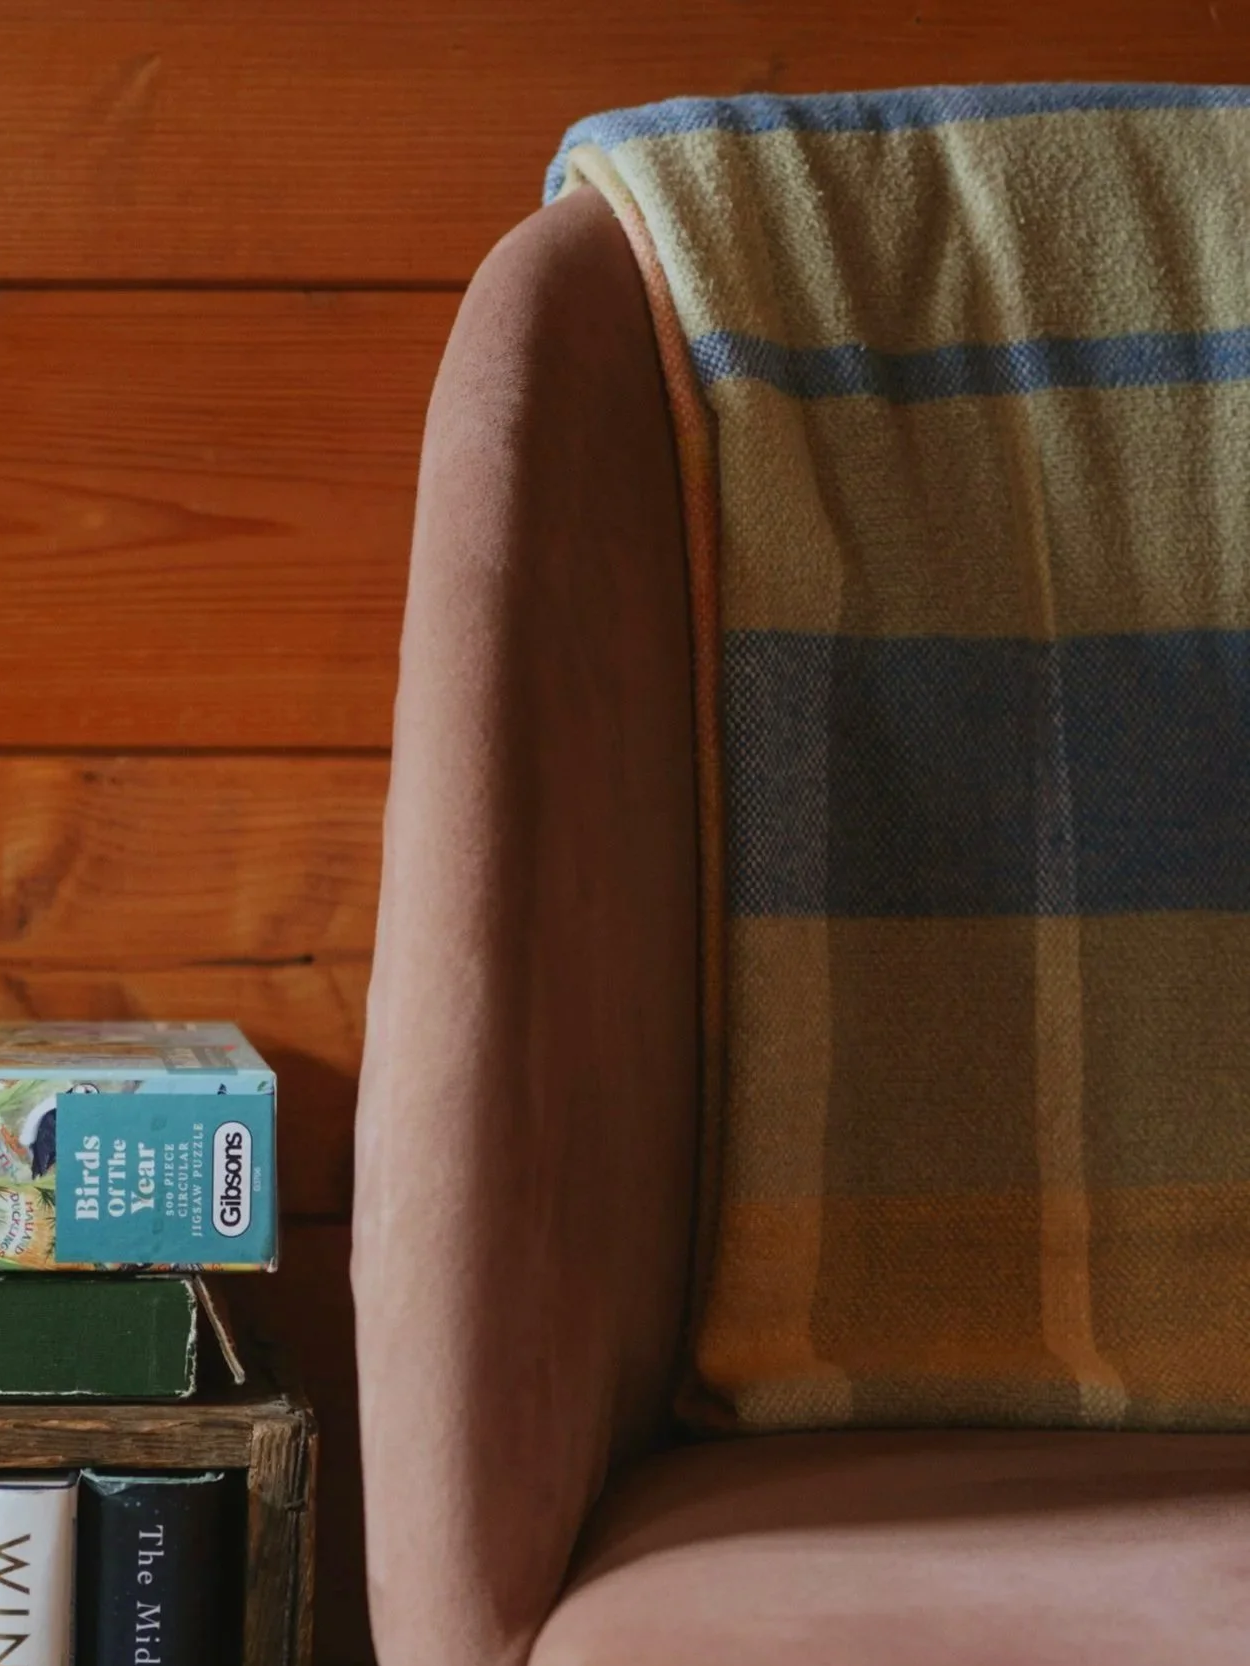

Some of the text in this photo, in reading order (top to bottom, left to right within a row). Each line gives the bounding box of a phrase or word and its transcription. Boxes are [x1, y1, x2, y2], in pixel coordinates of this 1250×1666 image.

[75, 1135, 100, 1221] Birds
[108, 1139, 126, 1217] Of The
[131, 1142, 155, 1214] Year
[165, 1143, 174, 1186] PIECE
[178, 1142, 189, 1217] CIRCULAR
[192, 1123, 203, 1237] JIGSAW PUZZLE
[220, 1132, 242, 1227] Gibsons
[136, 1524, 164, 1585] The
